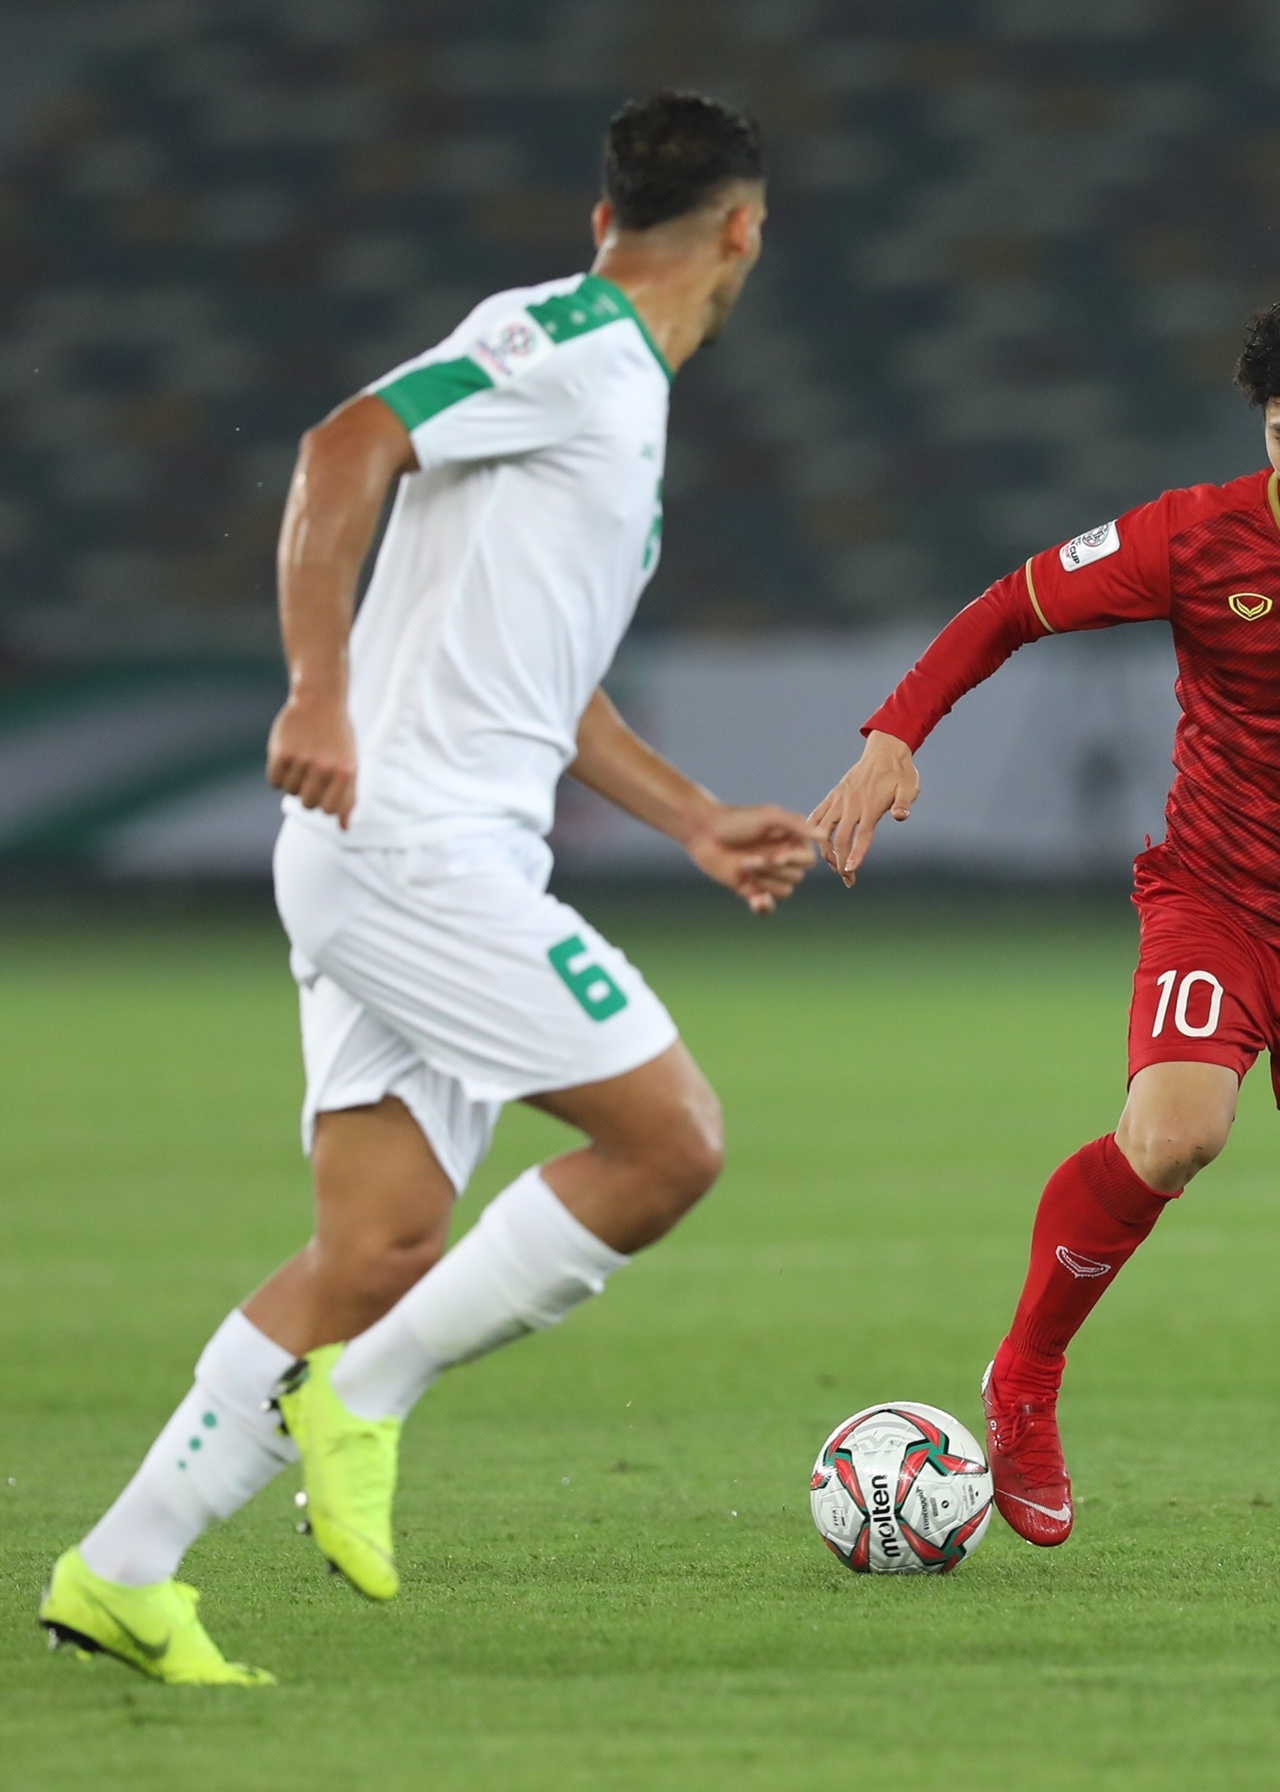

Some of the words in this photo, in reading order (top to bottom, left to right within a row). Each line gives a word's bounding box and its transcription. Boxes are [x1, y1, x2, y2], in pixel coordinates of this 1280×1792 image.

[1069, 545, 1080, 564] CUP
[547, 934, 628, 1022] 6
[1151, 969, 1224, 1038] 10
[871, 1474, 901, 1558] molten
